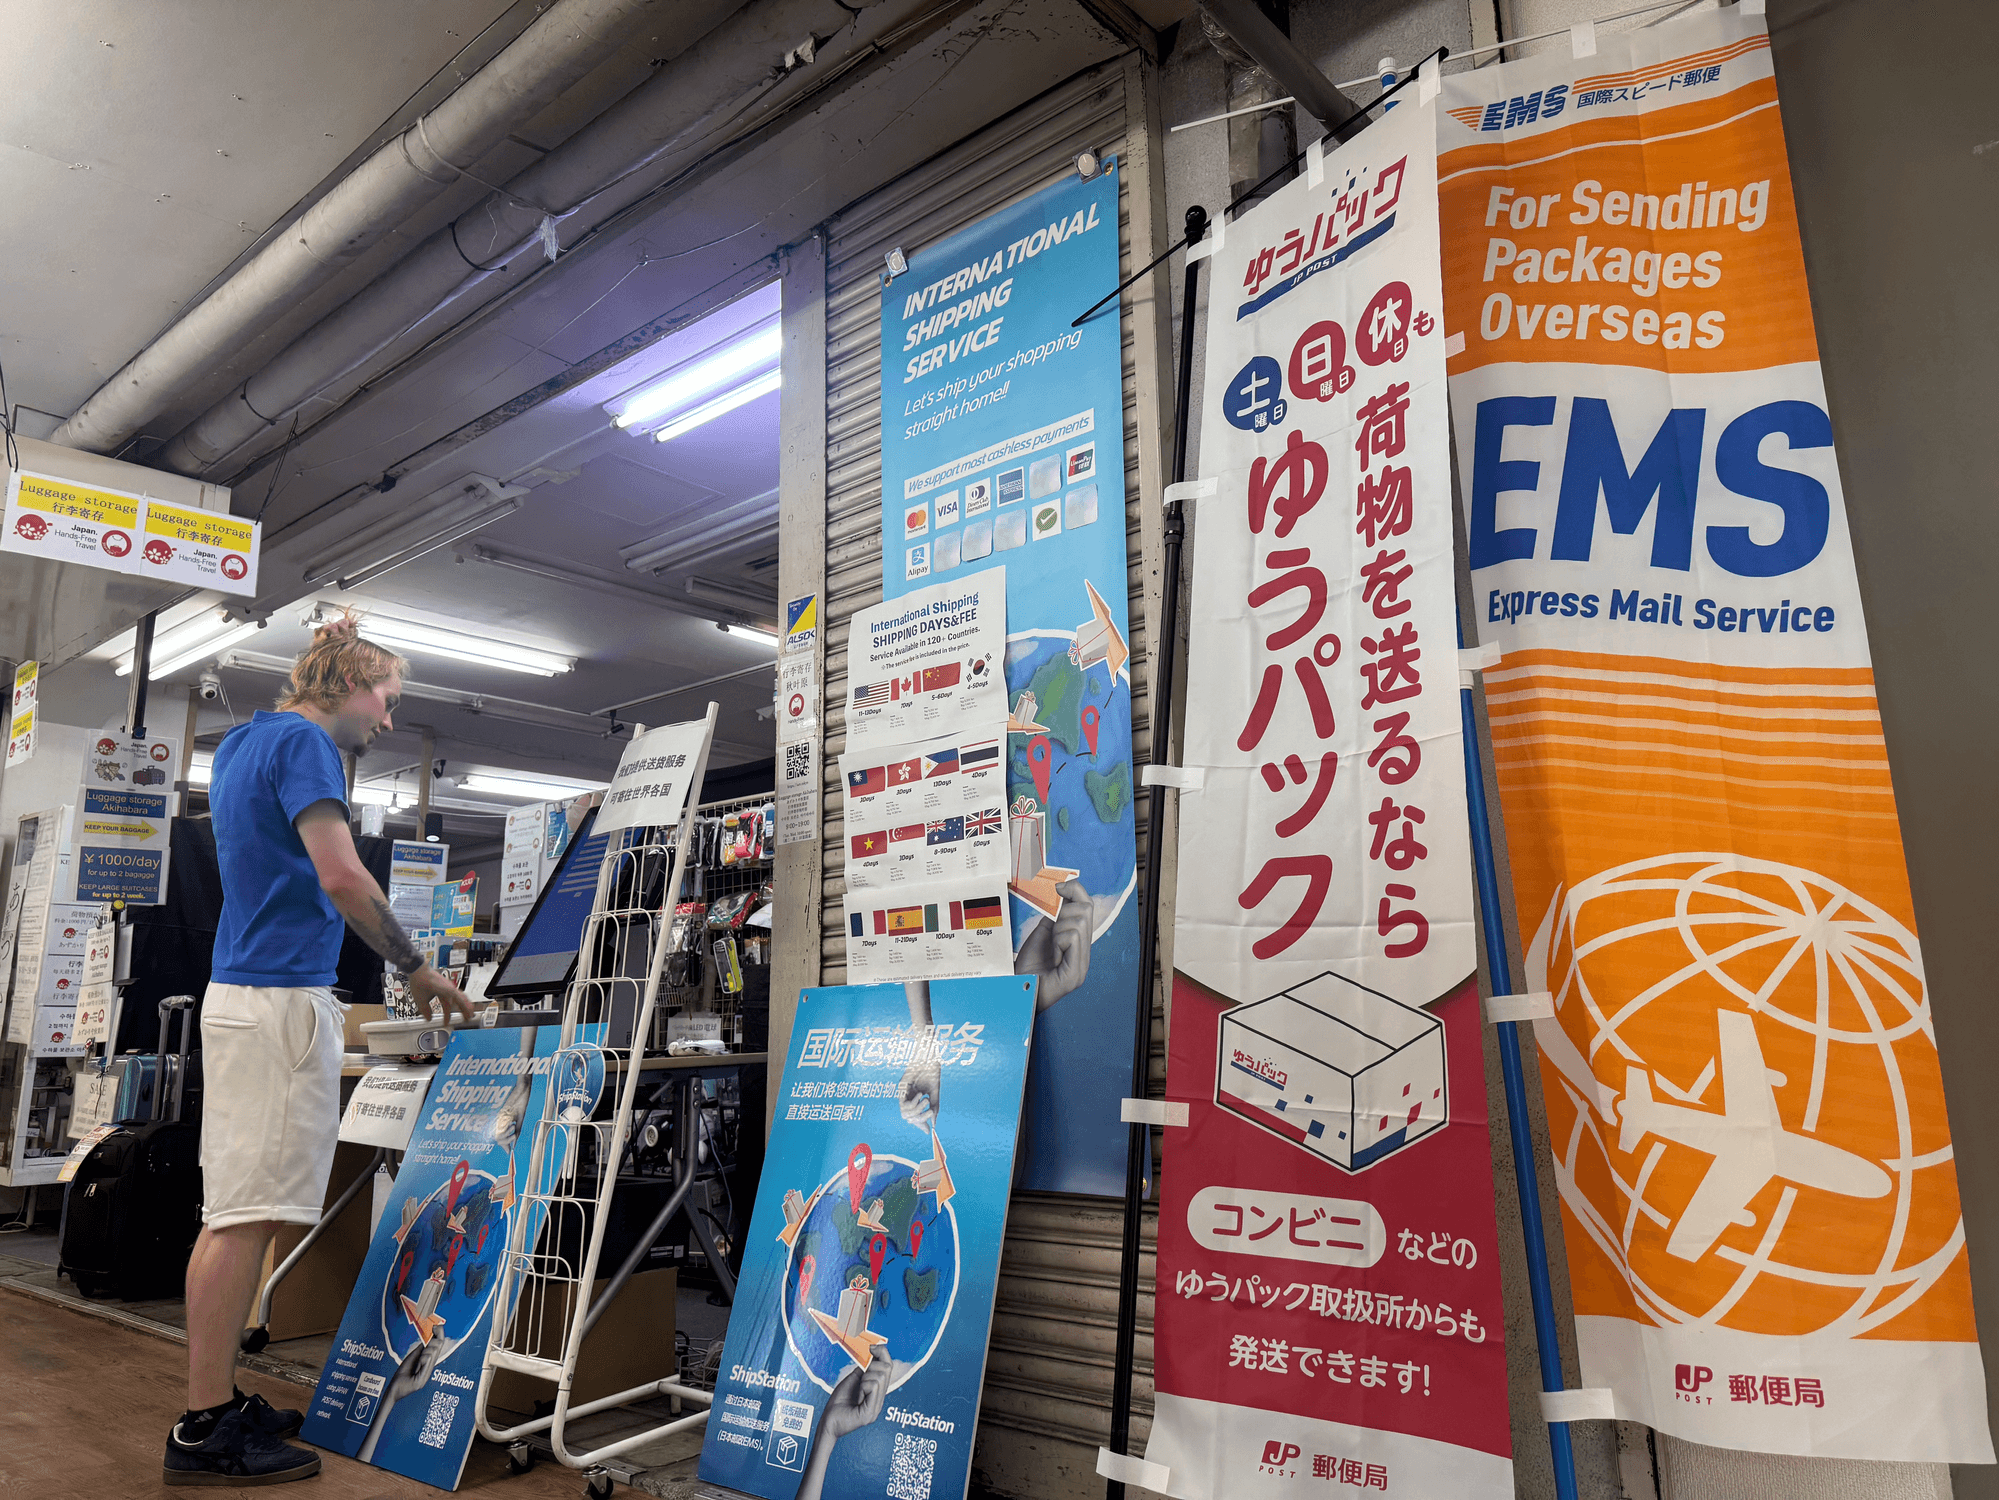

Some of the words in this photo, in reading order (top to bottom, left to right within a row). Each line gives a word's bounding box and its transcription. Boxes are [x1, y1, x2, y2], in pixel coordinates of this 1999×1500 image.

[1576, 65, 1722, 109] 国際スピード郵便
[1481, 84, 1569, 132] EMS
[1484, 185, 1561, 230] For
[1569, 179, 1770, 232] Sending
[1243, 154, 1408, 296] ゆうパック
[902, 202, 1100, 320] INTERNATIONAL
[1290, 272, 1304, 287] JP
[1306, 254, 1338, 276] POST
[1482, 236, 1723, 297] Packages
[903, 277, 1014, 352] SHIPPING
[1480, 292, 1726, 349] Overseas
[903, 316, 1004, 384] SERVICE
[936, 377, 967, 402] ship
[968, 361, 1006, 393] your
[1005, 329, 1083, 372] shopping
[904, 404, 958, 440] straight
[959, 380, 1011, 417] home!!
[908, 479, 924, 493] We
[924, 463, 960, 487] support
[960, 453, 987, 473] most
[987, 436, 1032, 462] cashless
[1032, 415, 1090, 449] payments
[20, 480, 76, 502] Luggage
[85, 495, 137, 515] storage
[1470, 396, 1834, 578] EMS
[52, 501, 104, 521] 行李寄存
[146, 507, 197, 527] Luggage
[205, 522, 252, 540] storage
[937, 501, 958, 517] VISA
[54, 529, 97, 544] Hands-Free
[71, 524, 98, 535] Japan.
[75, 541, 96, 551] Travel
[176, 527, 222, 546] 行李寄存
[178, 553, 217, 568] Hands-Free
[193, 548, 218, 559] Japan.
[197, 565, 216, 574] Travel
[908, 566, 928, 577] Alipay
[870, 604, 930, 633] International
[932, 592, 979, 614] Shipping
[1488, 589, 1600, 625] Express
[1609, 588, 1683, 627] Mail
[1694, 598, 1835, 633] Service
[787, 630, 815, 645] ALSOK
[870, 649, 894, 662] Service
[894, 641, 919, 656] Available
[919, 638, 926, 647] in
[947, 626, 981, 641] Countries.
[873, 625, 918, 649] SHIPPING
[920, 608, 977, 633] DAYS&FEE
[1356, 383, 1430, 959] 荷物を送るなら
[1237, 430, 1341, 960] ゆうパック
[618, 754, 687, 779] 我们提供送货服务
[86, 792, 127, 803] Luggage
[129, 796, 163, 807] storage
[102, 804, 148, 814] Akihabara
[610, 782, 672, 805] 可寄往世界各国
[797, 1021, 985, 1069] 国际运输服务
[1233, 1049, 1287, 1085] ゆうパック
[435, 1079, 512, 1110] Shipping
[790, 1082, 909, 1099] 让我们将您所购的物品
[425, 1107, 488, 1132] Service
[1212, 1202, 1364, 1251] コンビニ
[1397, 1226, 1478, 1270] などの
[1175, 1268, 1486, 1344] ゆうパック取扱所からも
[341, 1338, 385, 1361] ShipStation
[431, 1369, 475, 1391] ShipStation
[729, 1364, 801, 1394] ShipStation
[1675, 1363, 1714, 1393] JP
[1728, 1374, 1825, 1408] 郵便局
[1676, 1393, 1712, 1405] POST
[885, 1406, 955, 1434] ShipStation
[1261, 1440, 1301, 1466] JP
[1259, 1465, 1296, 1478] POST
[1312, 1454, 1388, 1491] 郵便局
